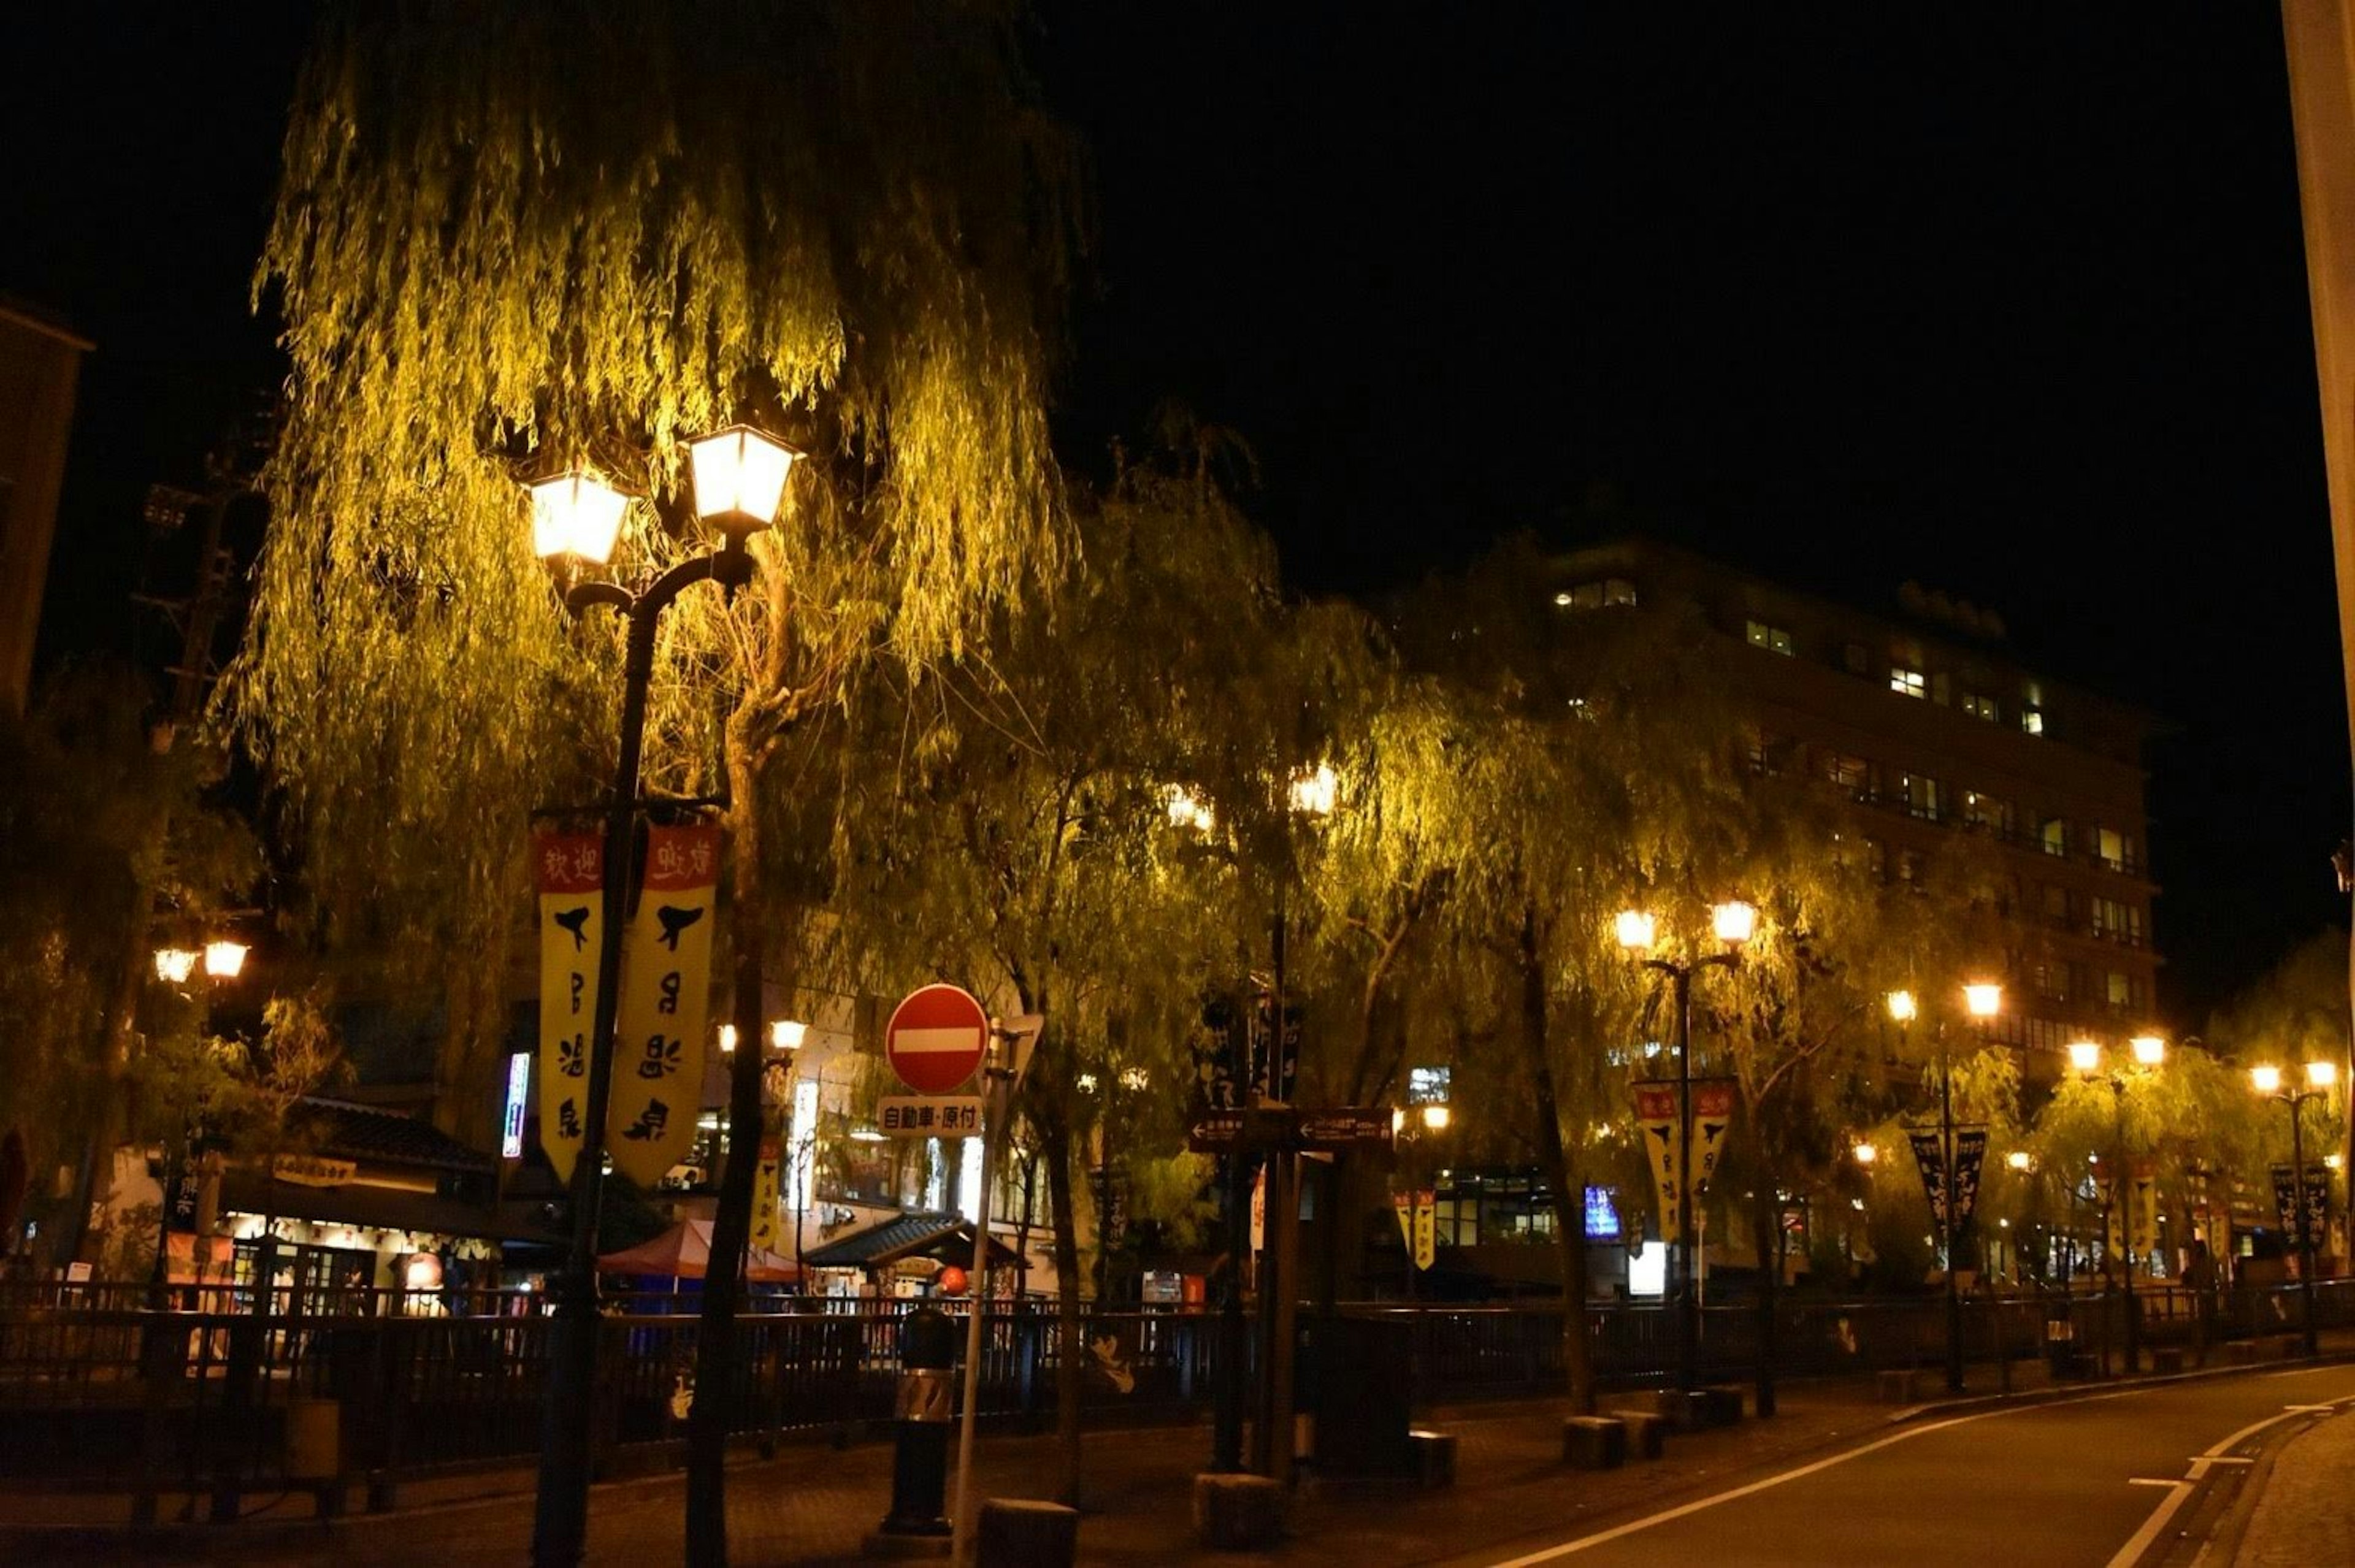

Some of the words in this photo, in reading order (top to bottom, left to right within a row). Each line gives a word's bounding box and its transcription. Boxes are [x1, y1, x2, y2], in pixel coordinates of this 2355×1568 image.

[545, 842, 600, 883] 歓迎
[884, 1106, 976, 1129] 自動車・原付
